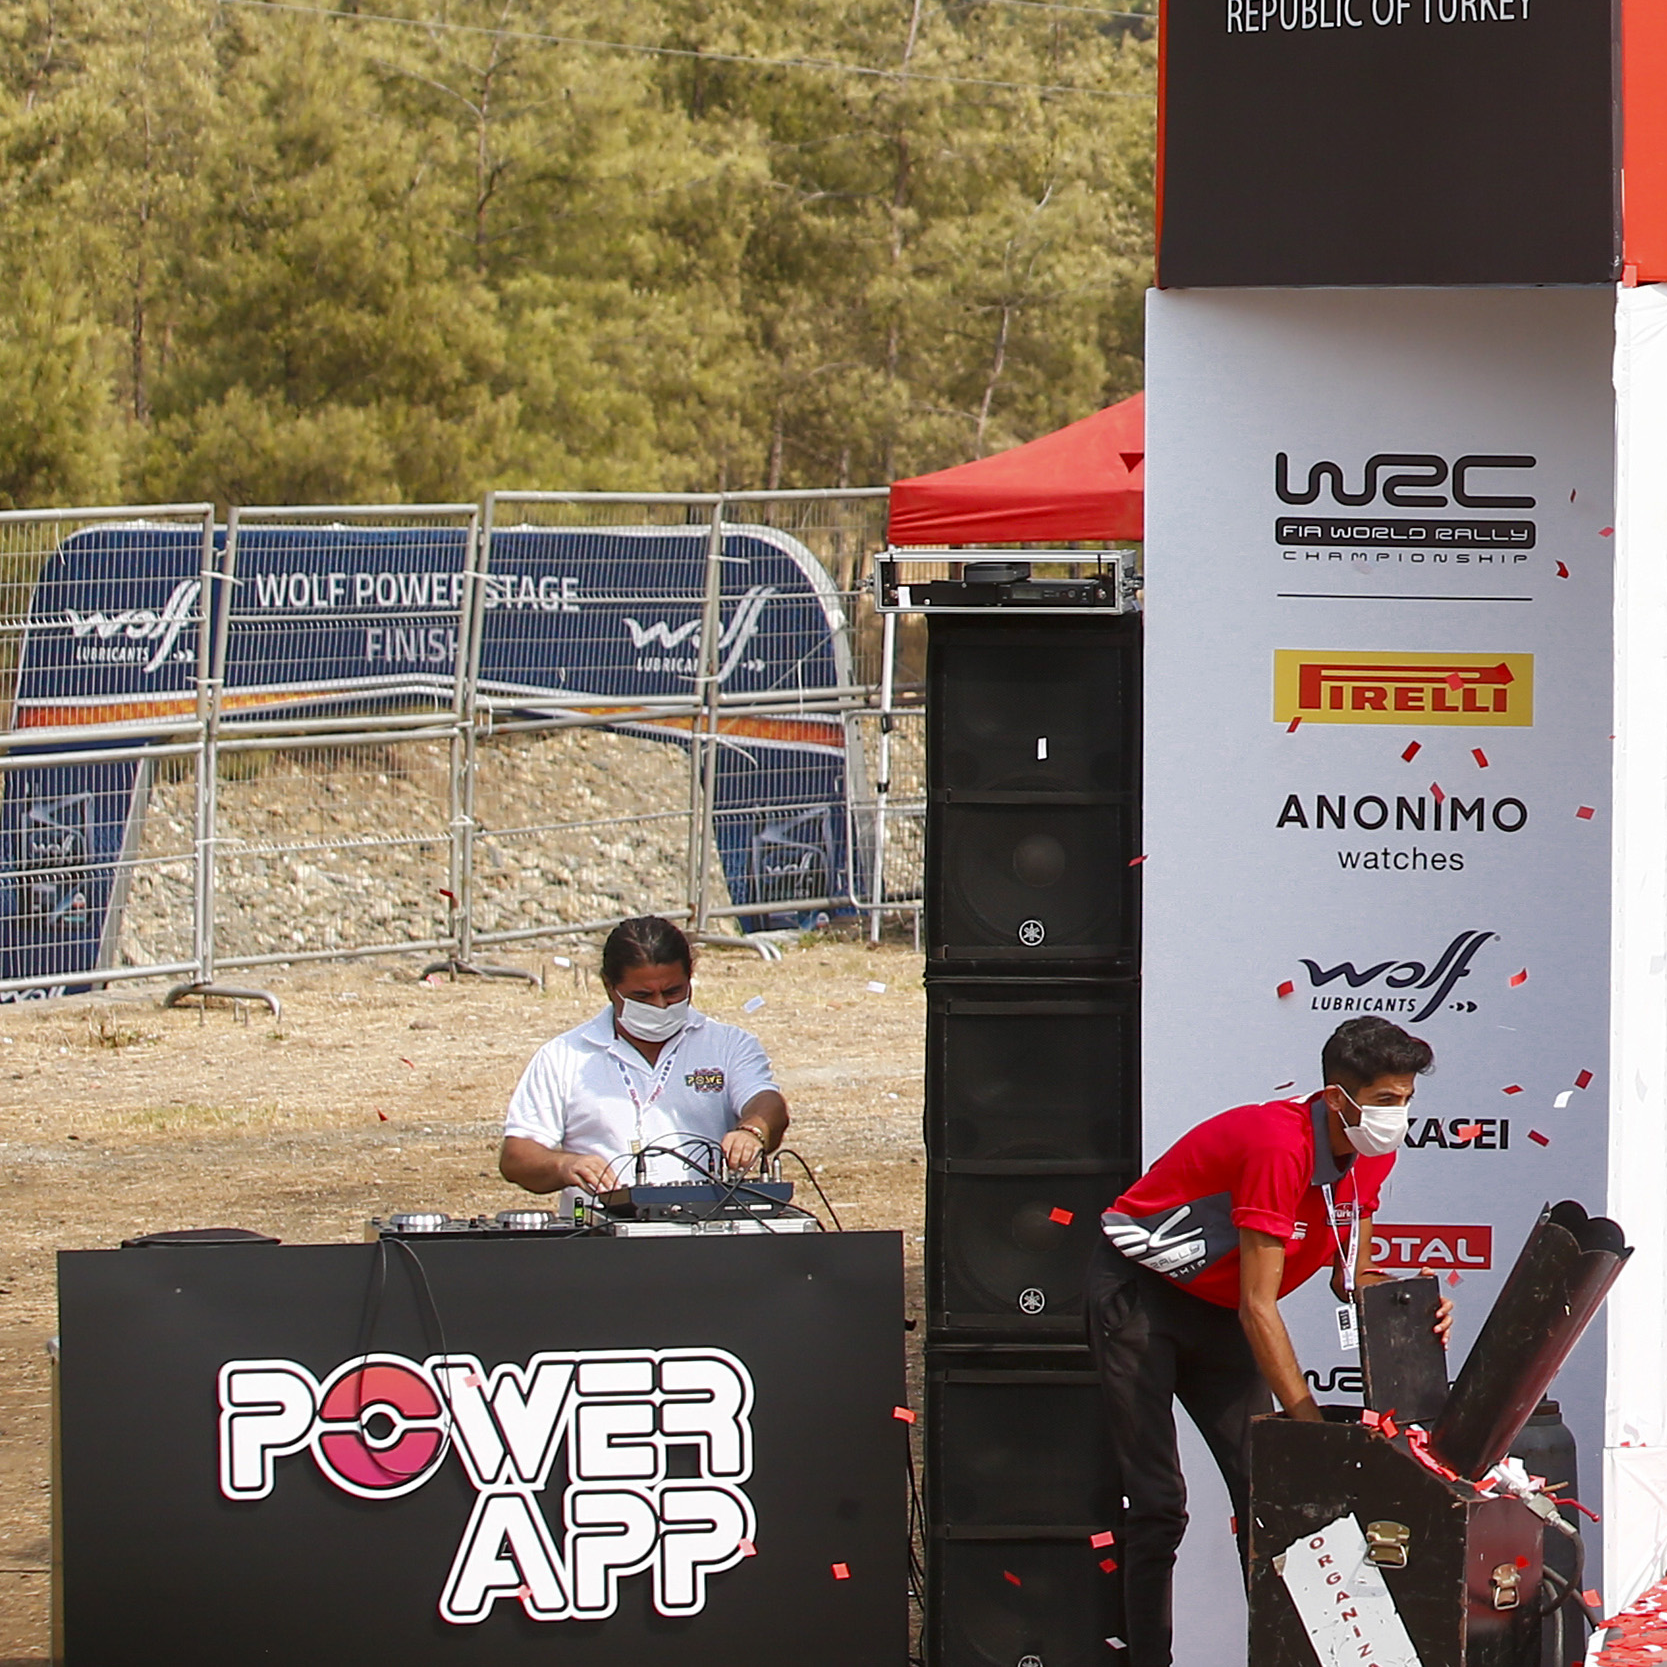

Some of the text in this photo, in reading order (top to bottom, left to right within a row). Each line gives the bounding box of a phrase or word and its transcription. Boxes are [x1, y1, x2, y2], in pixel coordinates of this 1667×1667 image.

[1275, 451, 1537, 509] WRC
[1282, 524, 1529, 542] FIA WORLD RALLY
[1282, 550, 1529, 565] CHAMPIONSHIP
[256, 574, 349, 608] WOLF
[1298, 663, 1515, 713] PIRELLI
[1276, 793, 1528, 833] ANONIMO
[1337, 847, 1465, 872] watches
[1298, 930, 1498, 1023] wolf
[1311, 996, 1418, 1014] LUBRICANTS
[219, 1348, 756, 1500] POWER
[439, 1483, 757, 1624] APP
